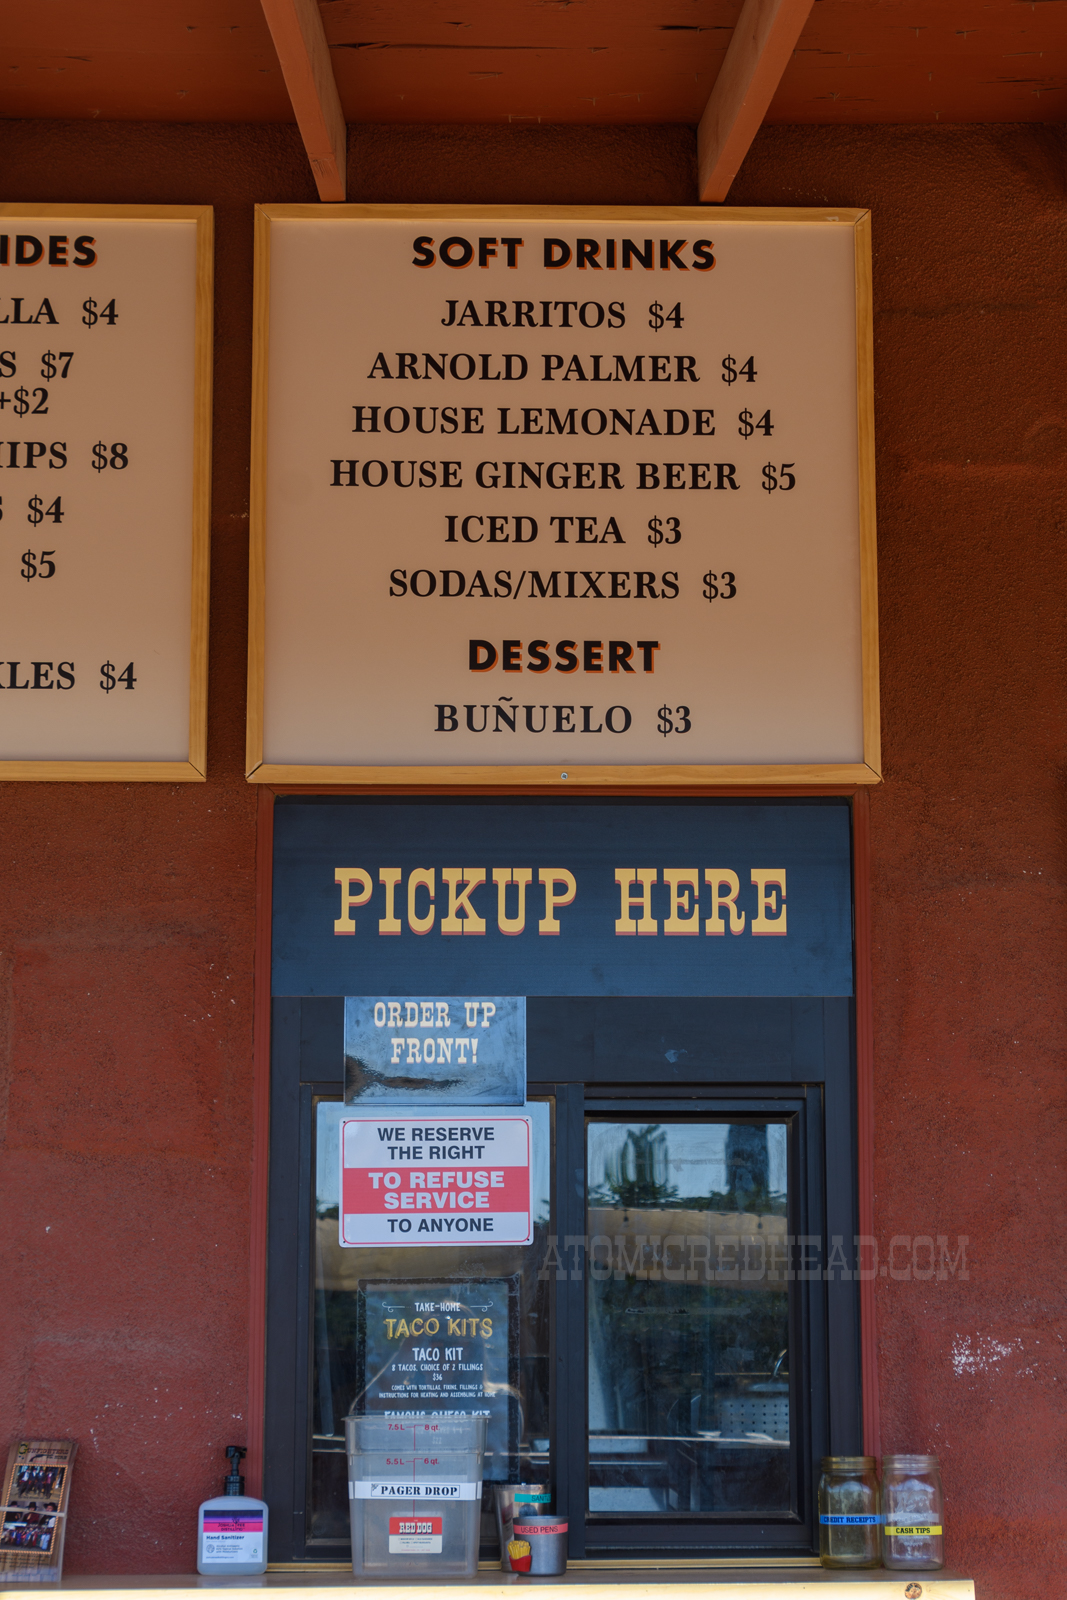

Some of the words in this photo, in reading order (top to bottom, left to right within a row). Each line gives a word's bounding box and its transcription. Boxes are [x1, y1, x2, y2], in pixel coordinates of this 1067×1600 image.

[412, 236, 524, 270] SOFT
[543, 238, 716, 272] DRINKS
[82, 297, 118, 329] $4
[441, 300, 625, 328] JARRITOS
[649, 300, 684, 332] $4
[41, 350, 74, 382] $7
[367, 352, 528, 380] ARNOLD
[542, 355, 700, 382] PALMER
[722, 354, 757, 386] $4
[352, 406, 484, 434] HOUSE
[497, 408, 715, 435] LEMONADE
[738, 408, 774, 440] $4
[0, 442, 67, 469] IPS
[92, 441, 128, 473] $8
[330, 460, 462, 488] HOUSE
[476, 461, 624, 489] GINGER
[636, 463, 740, 490] BEER
[762, 462, 795, 494] $5
[28, 494, 64, 527] $4
[445, 516, 538, 543] ICED
[550, 517, 626, 543] TEA
[648, 515, 681, 548] $3
[21, 549, 55, 582] $5
[390, 569, 679, 599] SODAS/MIXERS
[703, 570, 736, 603] $3
[468, 638, 661, 675] DESSERT
[100, 660, 137, 694] $4
[435, 697, 631, 733] BUÑUELO
[657, 704, 691, 737] $3
[333, 867, 578, 936] PICKUP
[614, 867, 788, 937] HERE
[373, 1001, 452, 1029] ORDER
[465, 1001, 497, 1028] UP
[390, 1037, 479, 1065] FRONT!
[377, 1127, 408, 1142] WE
[411, 1127, 495, 1142] RESERVE
[387, 1145, 425, 1160] THE
[429, 1145, 486, 1160] RIGHT
[368, 1172, 404, 1190] TO
[409, 1171, 506, 1189] REFUSE
[383, 1191, 490, 1209] SERVICE
[387, 1219, 414, 1233] TO
[417, 1218, 494, 1233] ANYONE
[414, 1302, 461, 1312] TAKE-HOME
[383, 1318, 440, 1340] TACO
[448, 1318, 493, 1339] KITS
[412, 1347, 440, 1361] TACO
[445, 1347, 463, 1361] KIT
[433, 1373, 443, 1381] $36
[381, 1486, 421, 1496] PAGER
[425, 1487, 457, 1496] DROP
[399, 1522, 416, 1534] RED
